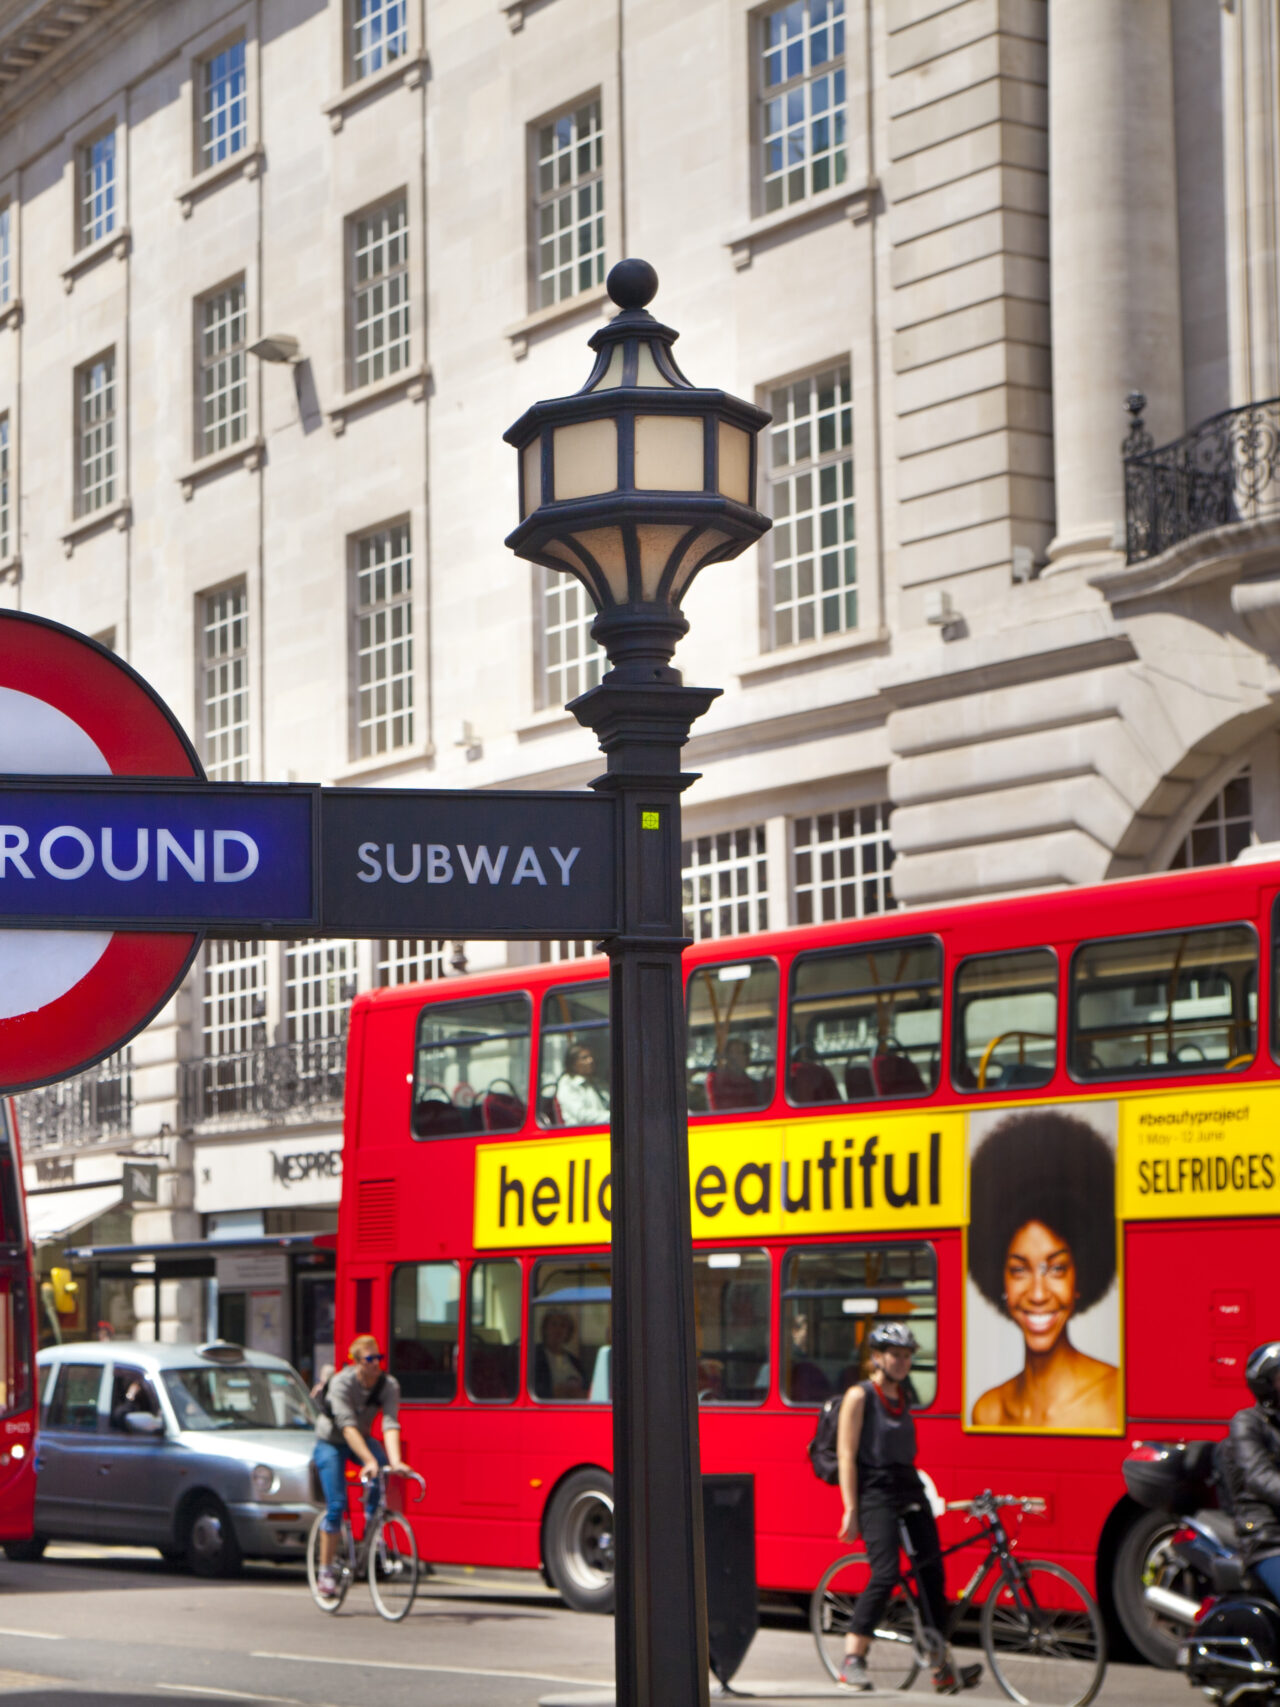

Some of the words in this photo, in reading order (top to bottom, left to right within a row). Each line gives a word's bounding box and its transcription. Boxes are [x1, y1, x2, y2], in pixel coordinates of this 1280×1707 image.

[356, 841, 582, 886] SUBWAY
[1139, 1106, 1250, 1126] #beautyproject
[1147, 1133, 1171, 1146] May
[1198, 1130, 1225, 1143] June
[269, 1150, 343, 1189] NESPRE
[694, 1132, 941, 1217] eautiful
[1138, 1153, 1276, 1195] SELFRIDGES
